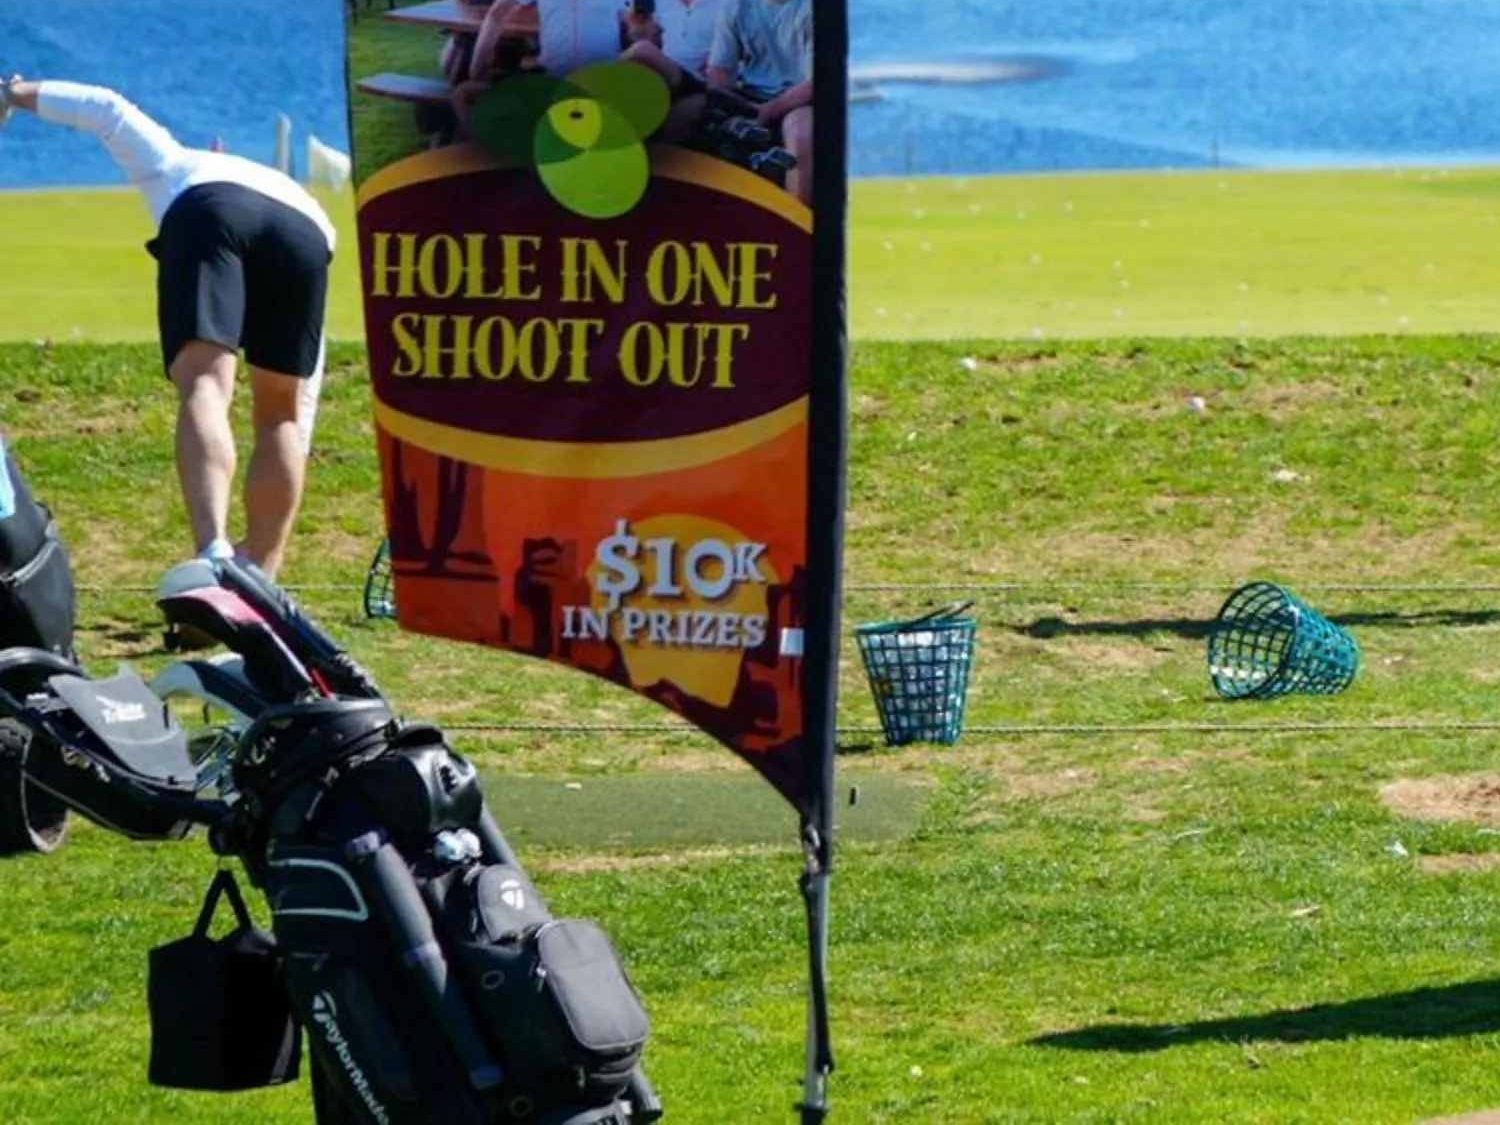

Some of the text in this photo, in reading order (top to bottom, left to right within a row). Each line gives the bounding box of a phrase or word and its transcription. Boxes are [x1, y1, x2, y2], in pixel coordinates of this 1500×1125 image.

[371, 232, 779, 311] HOLE IN ONE
[391, 312, 750, 389] SHOOT OUT
[594, 517, 767, 610] $10K
[561, 606, 767, 649] IN PRIZES
